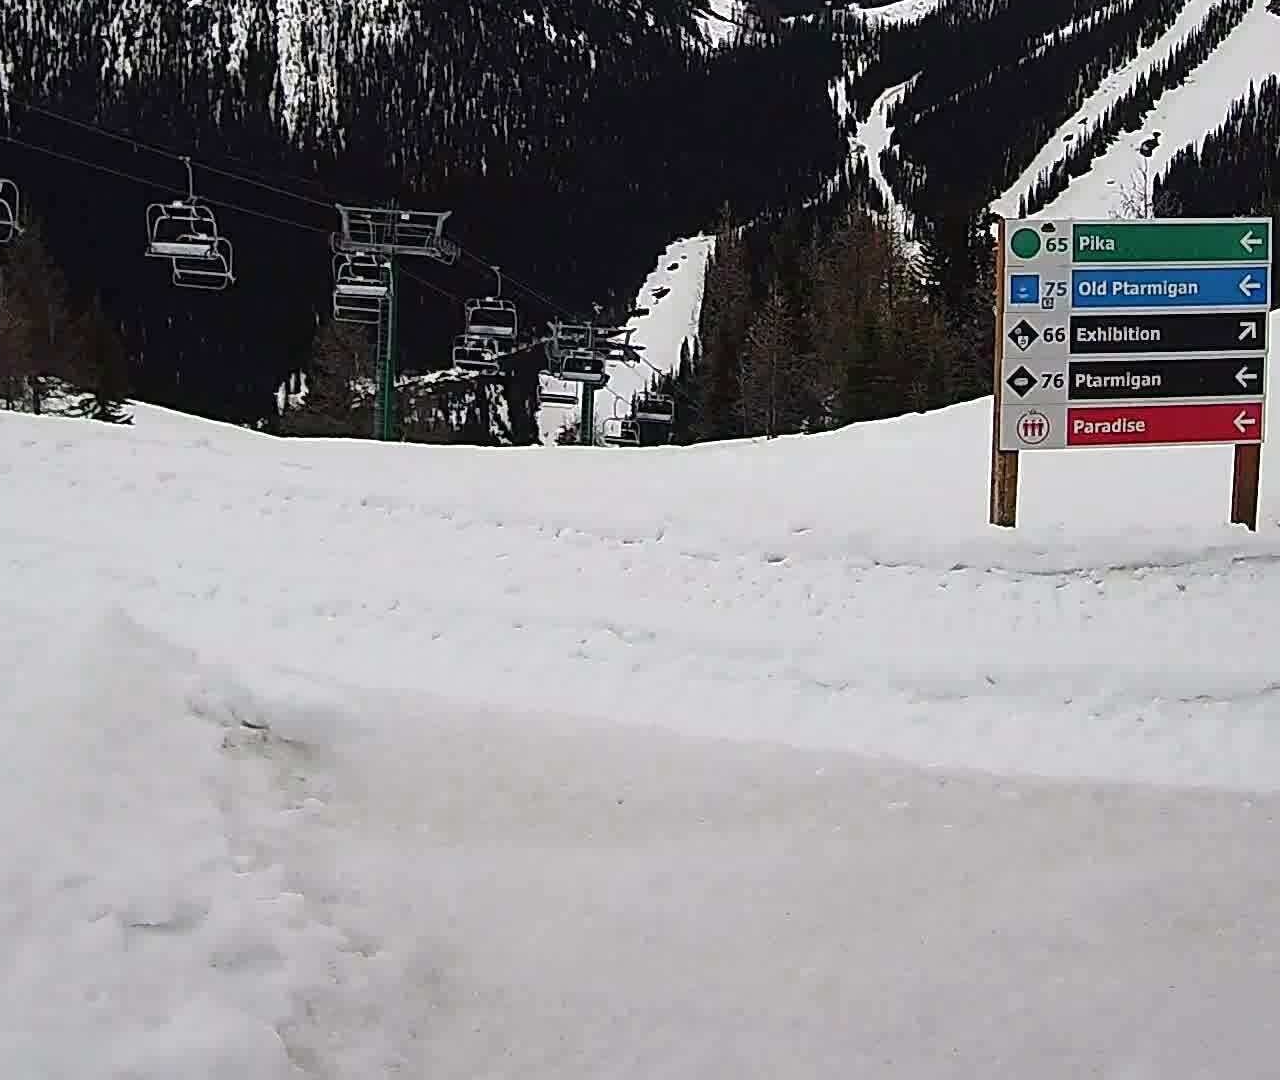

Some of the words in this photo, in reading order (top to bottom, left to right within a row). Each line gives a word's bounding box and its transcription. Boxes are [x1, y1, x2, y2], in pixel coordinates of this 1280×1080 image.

[1045, 237, 1068, 253] 65
[1079, 236, 1115, 252] Pika
[1044, 281, 1068, 297] 75
[1078, 281, 1109, 296] Old
[1112, 280, 1198, 298] Ptarmigan
[1043, 327, 1066, 343] 66
[1076, 325, 1161, 342] Exhibition
[1041, 373, 1065, 389] 76
[1075, 372, 1162, 390] Ptarmigan
[1073, 418, 1146, 434] Paradise
